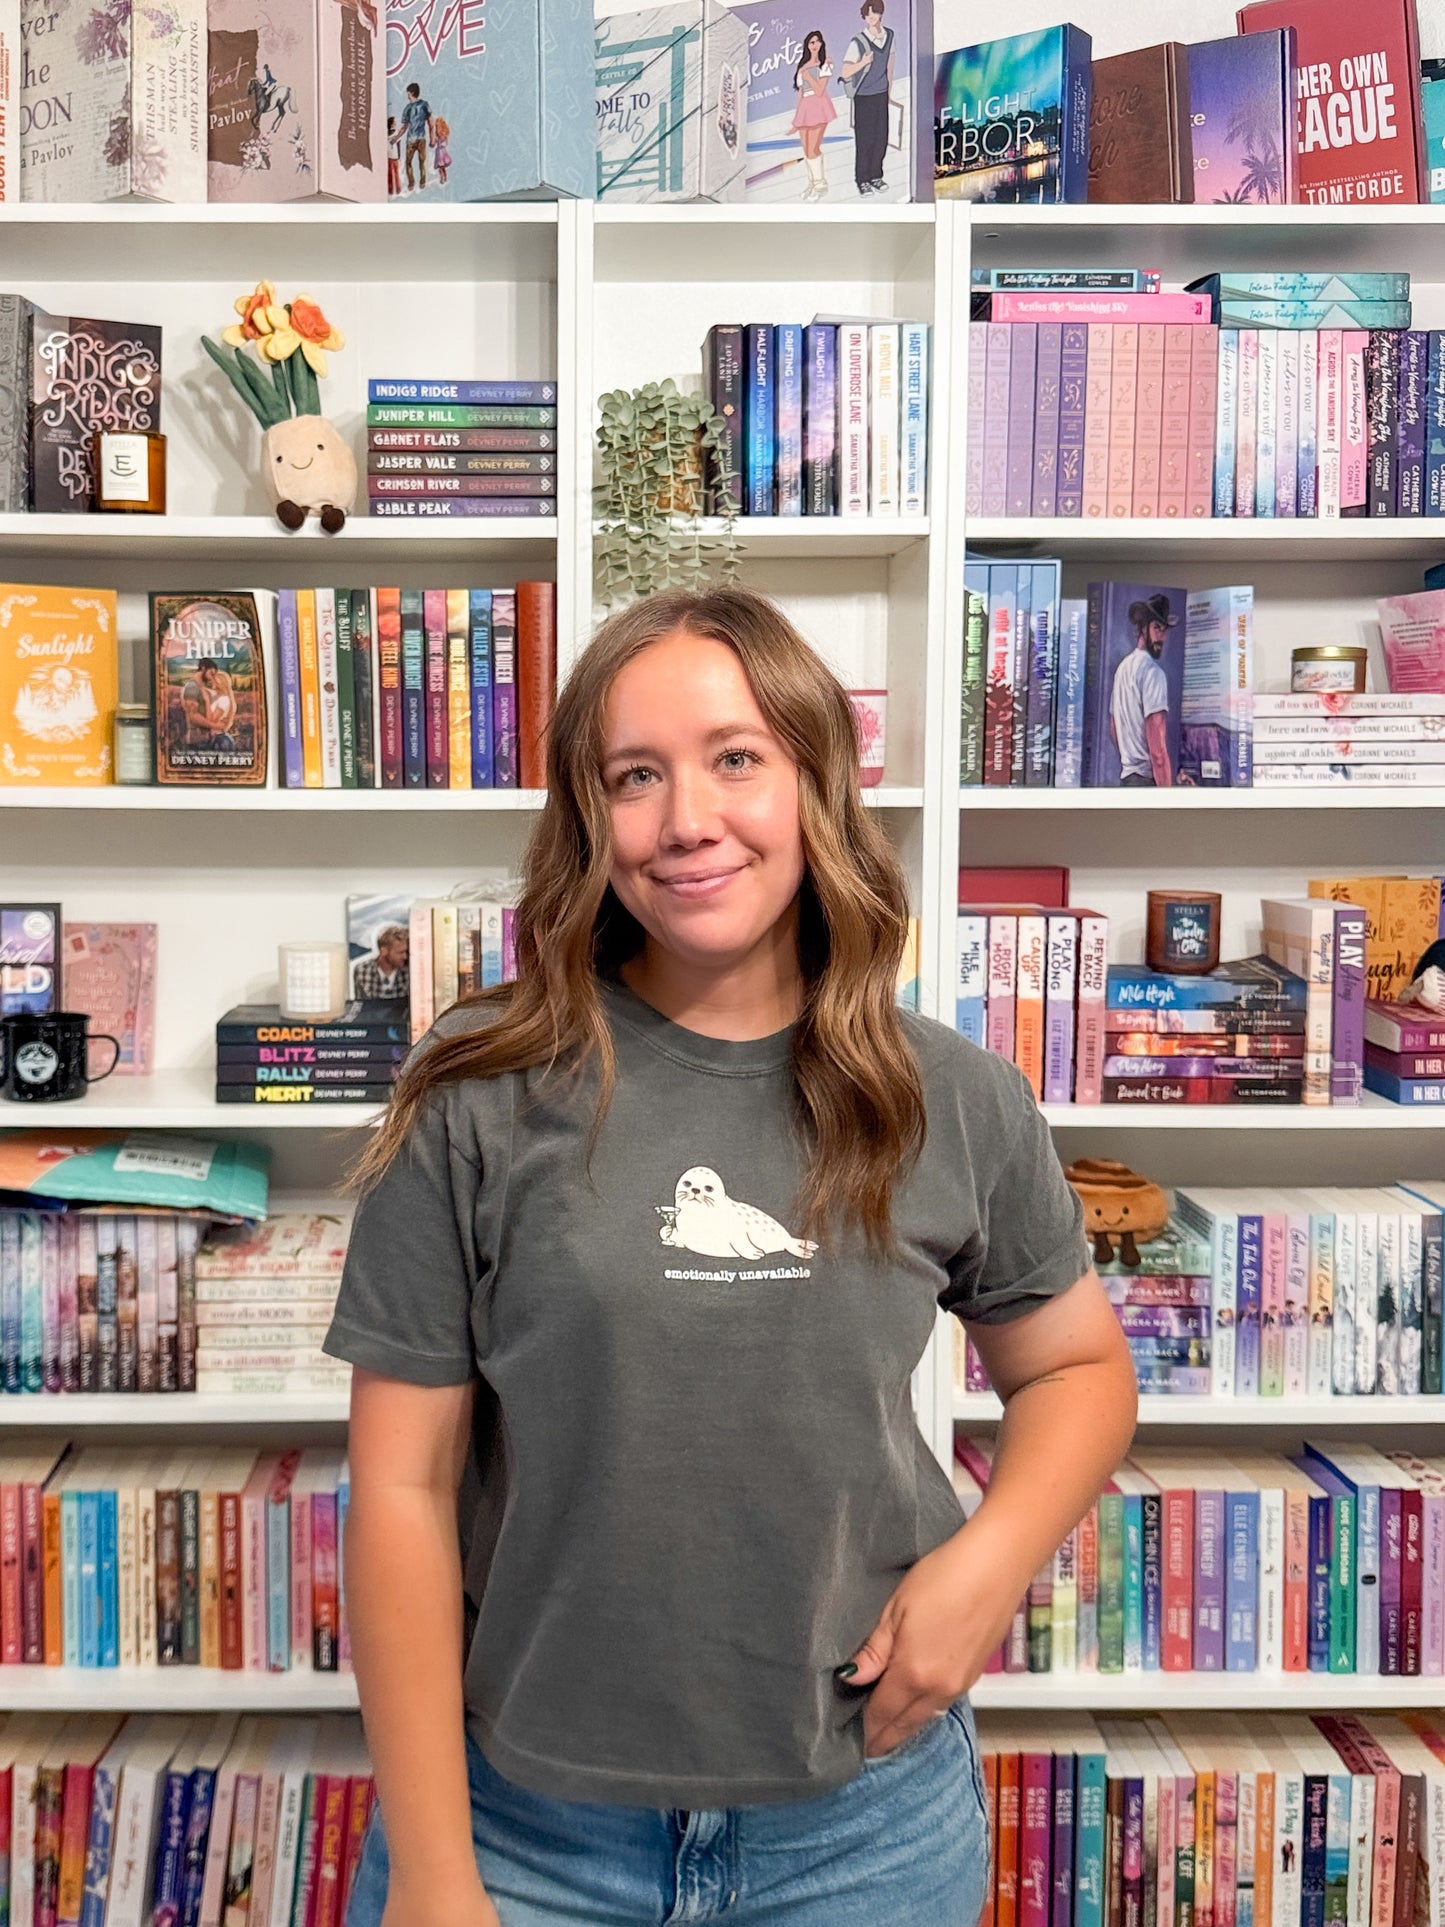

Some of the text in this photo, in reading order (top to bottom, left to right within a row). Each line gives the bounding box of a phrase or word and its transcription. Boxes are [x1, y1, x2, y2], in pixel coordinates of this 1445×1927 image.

[180, 68, 188, 101] breath
[1297, 51, 1389, 99] HER OWN
[145, 63, 155, 141] THIS MAN
[169, 56, 178, 135] STEALING
[347, 95, 357, 123] there
[358, 80, 367, 131] HORSE
[632, 92, 650, 111] TO
[939, 88, 1037, 130] F-LIGHT
[190, 100, 200, 153] SIMPLY
[209, 108, 253, 130] Pavlov
[31, 143, 73, 166] Pavlov
[1306, 175, 1404, 205] TOMFORDE
[1329, 174, 1371, 184] BESTSELLING
[1372, 169, 1399, 177] AUTHOR
[39, 331, 159, 389] INDIGO
[756, 329, 766, 387] HALF-LIGHT
[784, 331, 793, 377] DRIFTING
[816, 331, 825, 379] TWILIGHT
[376, 385, 458, 398] INDIGO RIDGE
[849, 333, 861, 424] ON LOVEROSE LANE
[908, 333, 921, 421] HART STREET LANE
[43, 377, 155, 434] RIDGE
[1327, 351, 1336, 442] ACROSS VANISHING SKY
[375, 409, 455, 422] JUNIPER HILL
[374, 434, 460, 446] GARNET FLATS
[908, 433, 917, 470] SAMANTHA
[377, 457, 456, 469] JASPER VALE
[468, 461, 531, 469] DEVNEY PERRY
[849, 434, 859, 494] SAMANTHA YOUNG
[1382, 452, 1390, 492] CATHERINE
[377, 479, 460, 490] CRIMSON RIVER
[1402, 471, 1410, 507] COWLES
[1411, 465, 1420, 513] CATHERINE
[377, 503, 451, 515] SABLE PEAK
[166, 618, 252, 640] JUNIPER
[338, 600, 351, 652] THE BLUFF
[965, 616, 984, 654] simple
[17, 633, 95, 663] Sunlight
[185, 639, 235, 659] HILL
[381, 641, 398, 688] STEEL KING
[430, 633, 444, 692] STONE PRINCESS
[473, 627, 488, 688] FALLEN JESTER
[495, 636, 513, 684] TIN QUEEN
[405, 659, 421, 690] KNIGHT
[1351, 702, 1413, 710] CORINNE MICHAELS
[171, 756, 254, 766] DEVNEY PERRY
[343, 710, 353, 778] DEVNEY PERRY
[970, 942, 980, 972] MILE
[993, 942, 1002, 981] MOVE
[1062, 938, 1072, 973] PLAY
[1340, 921, 1363, 968] PLAY
[961, 953, 970, 985] HIGH
[1001, 949, 1011, 988] RIGHT
[1021, 955, 1030, 972] UP
[1030, 937, 1041, 992] CAUGHT
[1051, 942, 1061, 990] ALONG
[1083, 954, 1092, 988] BACK
[1093, 938, 1104, 990] REWIND
[256, 1028, 314, 1042] COACH
[259, 1048, 316, 1062] BLITZ
[256, 1067, 313, 1081] RALLY
[255, 1086, 314, 1102] MERIT
[1413, 1086, 1441, 1100] IN HER
[664, 1267, 811, 1283] emotionally unavailable
[1340, 1500, 1350, 1524] LOVE
[1200, 1526, 1214, 1578] KENNEDY
[1233, 1504, 1247, 1582] ELLE KENNEDY
